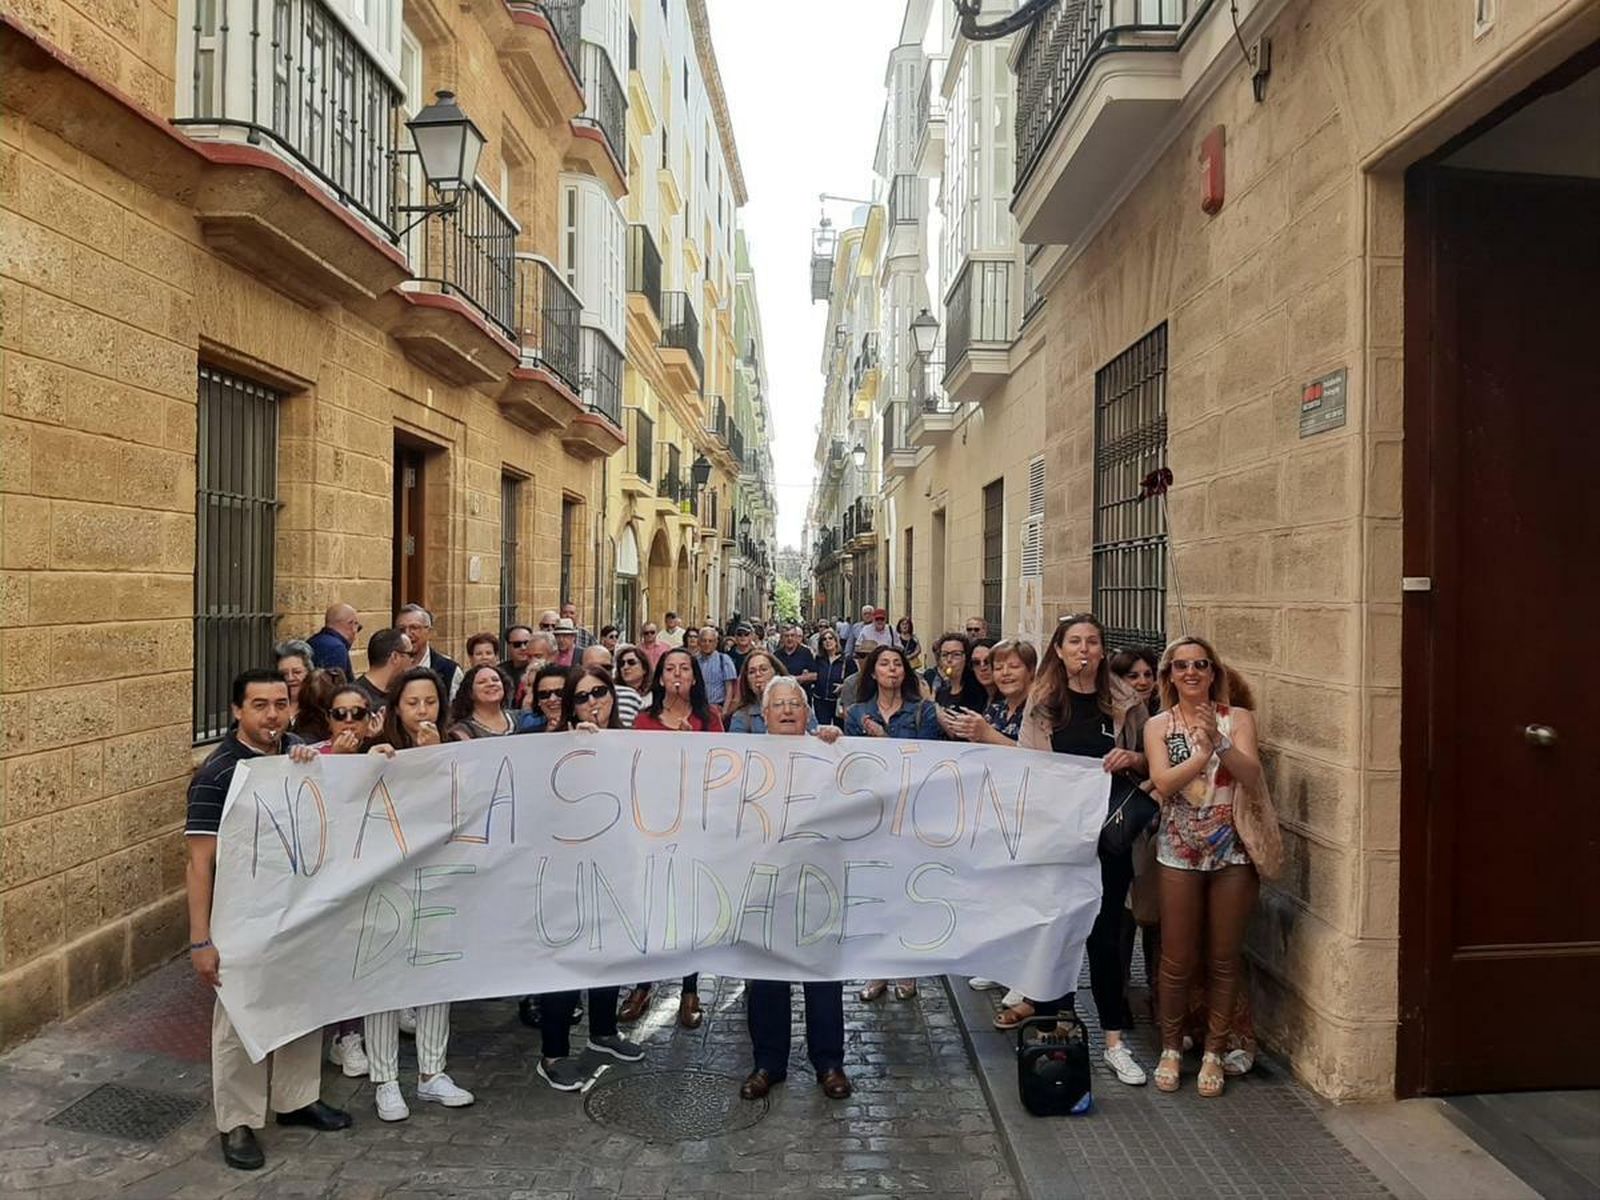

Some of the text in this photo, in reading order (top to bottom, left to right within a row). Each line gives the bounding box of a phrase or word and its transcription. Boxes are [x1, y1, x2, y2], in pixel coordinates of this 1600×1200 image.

[252, 776, 328, 879] NO
[353, 775, 408, 859] A
[448, 755, 515, 844] LA
[352, 844, 957, 980] DE UNIDADES
